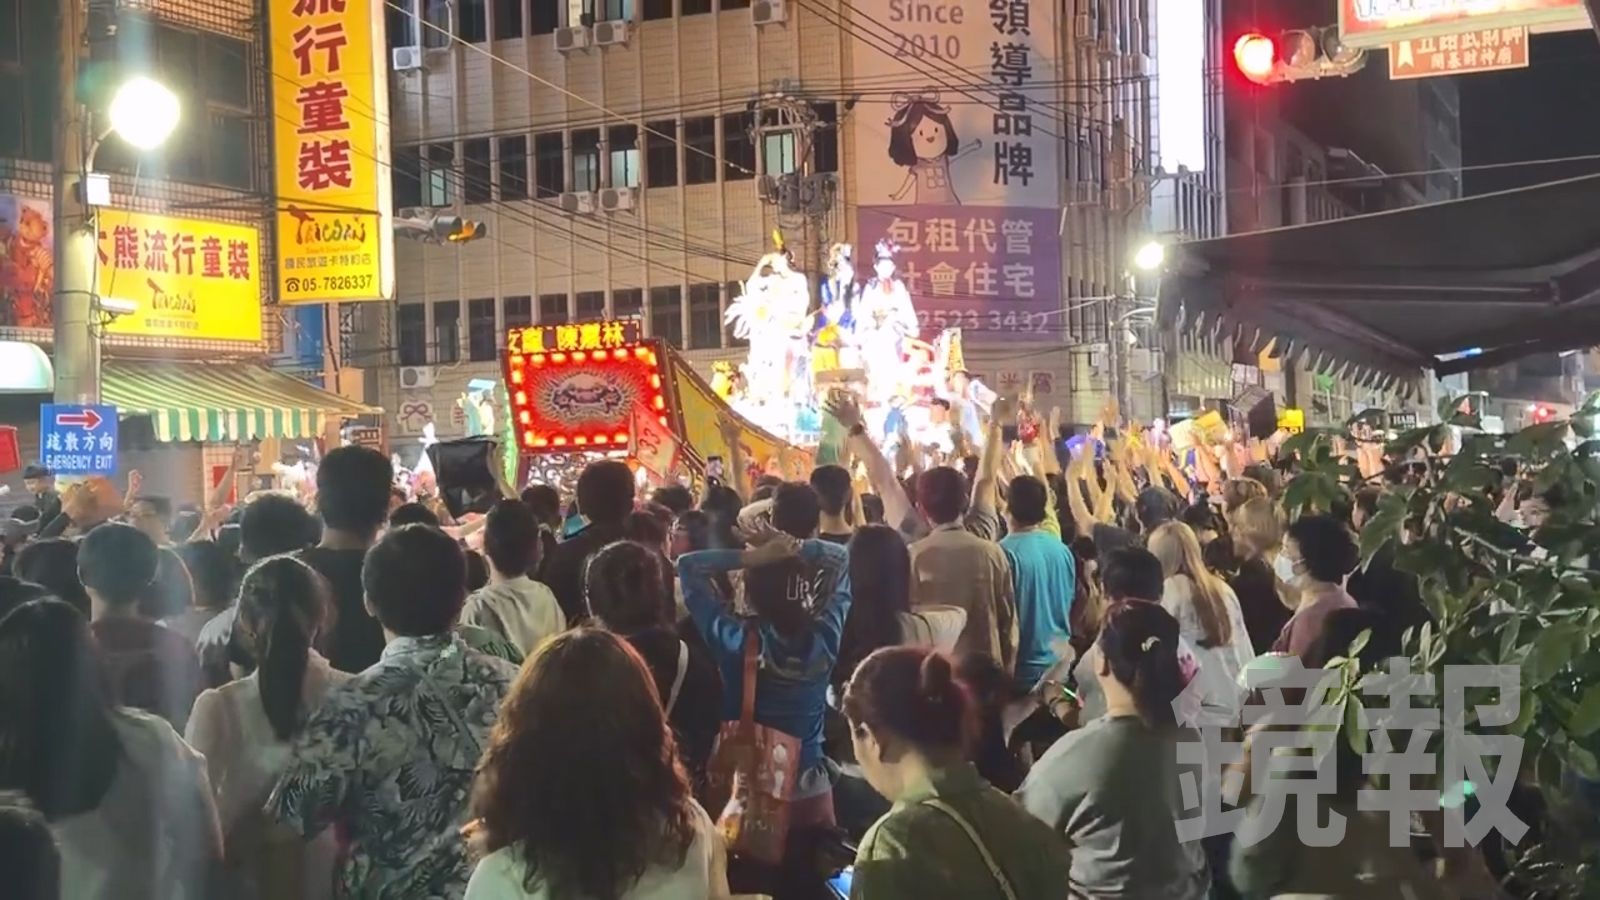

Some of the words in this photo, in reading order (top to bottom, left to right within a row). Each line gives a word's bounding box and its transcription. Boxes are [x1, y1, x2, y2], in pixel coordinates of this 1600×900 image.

[889, 0, 964, 25] Since
[893, 34, 960, 60] 2010
[988, 0, 1034, 188] 領導品牌
[886, 217, 1034, 256] 包租代管
[302, 274, 373, 292] 05-7826337
[988, 309, 1049, 333] 3432
[46, 455, 92, 470] EMERGENCY
[95, 454, 113, 470] EXIT
